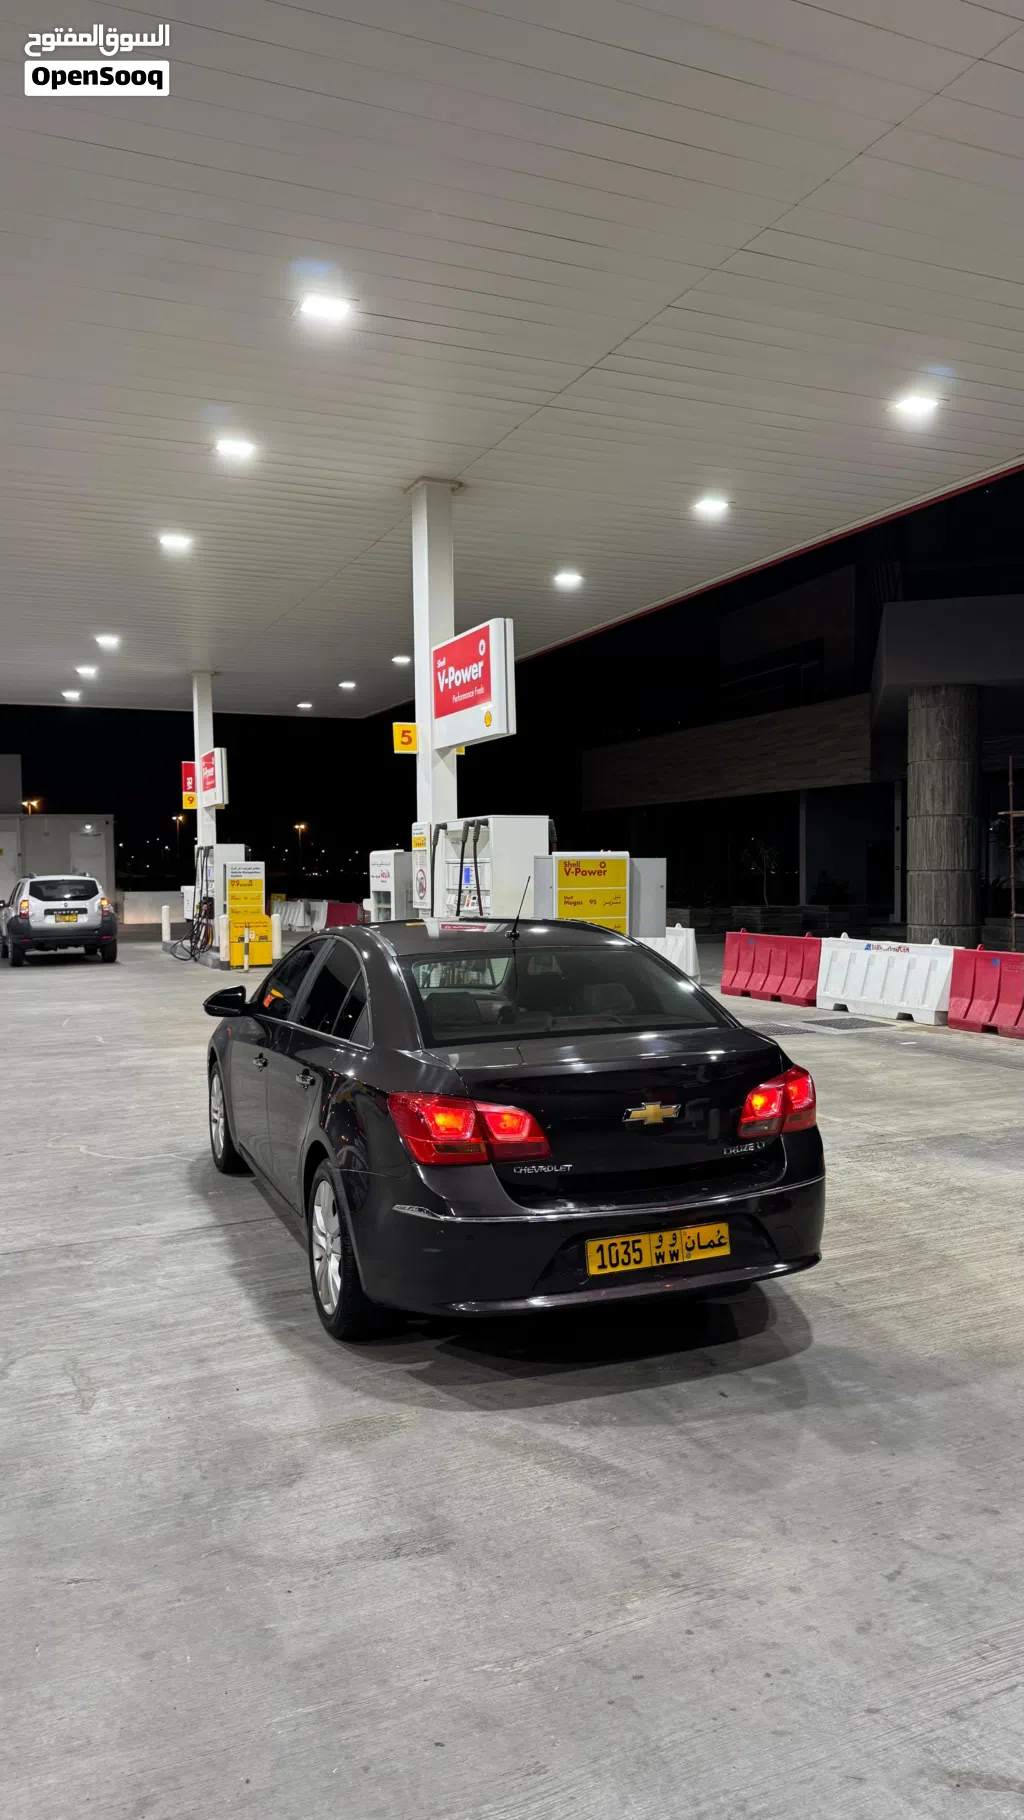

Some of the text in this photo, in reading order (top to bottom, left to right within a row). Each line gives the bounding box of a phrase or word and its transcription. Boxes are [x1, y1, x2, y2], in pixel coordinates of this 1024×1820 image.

[436, 657, 446, 669] Shell
[437, 660, 484, 693] V-Power
[452, 691, 475, 704] Performance
[400, 730, 413, 746] 5
[187, 796, 195, 805] 9
[564, 867, 607, 877] V-Power
[723, 1142, 755, 1155] CRUZE
[513, 1164, 573, 1174] CHEVROLET
[596, 1239, 643, 1269] 1035
